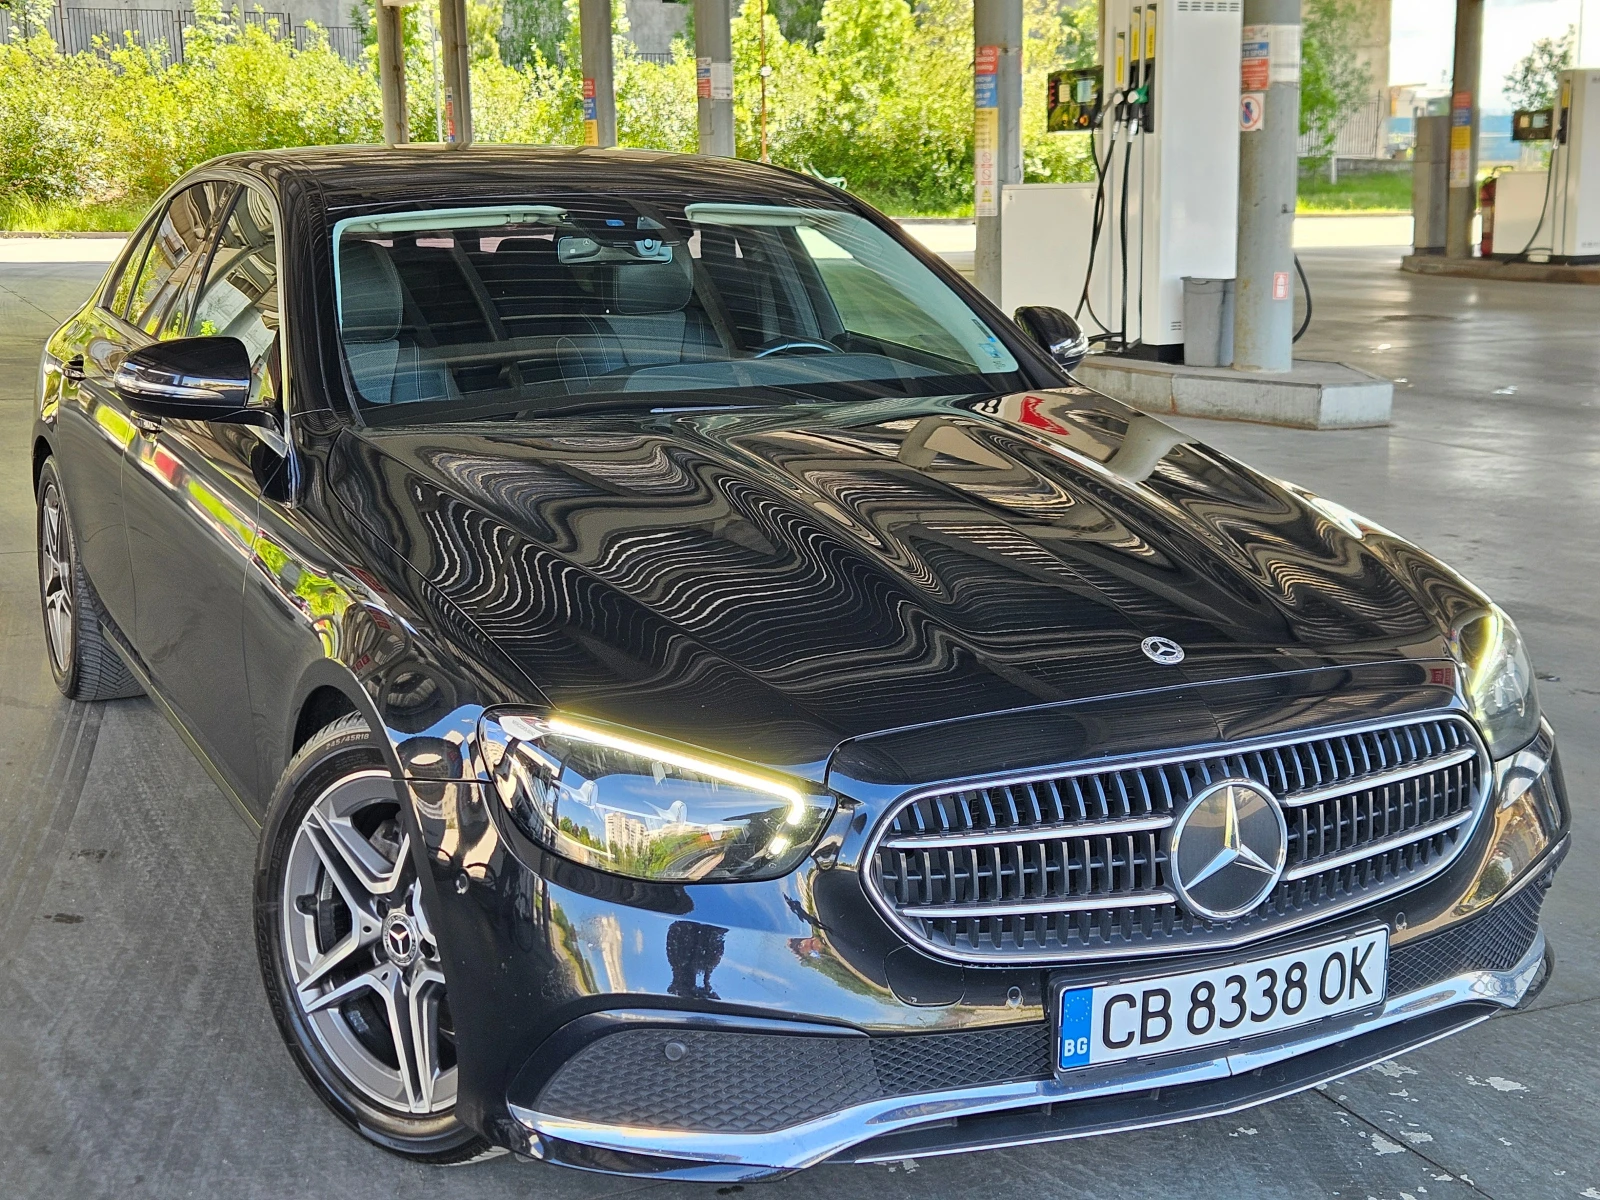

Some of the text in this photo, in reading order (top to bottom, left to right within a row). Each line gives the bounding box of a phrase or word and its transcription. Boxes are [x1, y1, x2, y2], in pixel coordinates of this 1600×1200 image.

[325, 733, 370, 751] 245/45R18
[1102, 941, 1376, 1050] CB 8338 OK
[1064, 1037, 1088, 1057] BG
